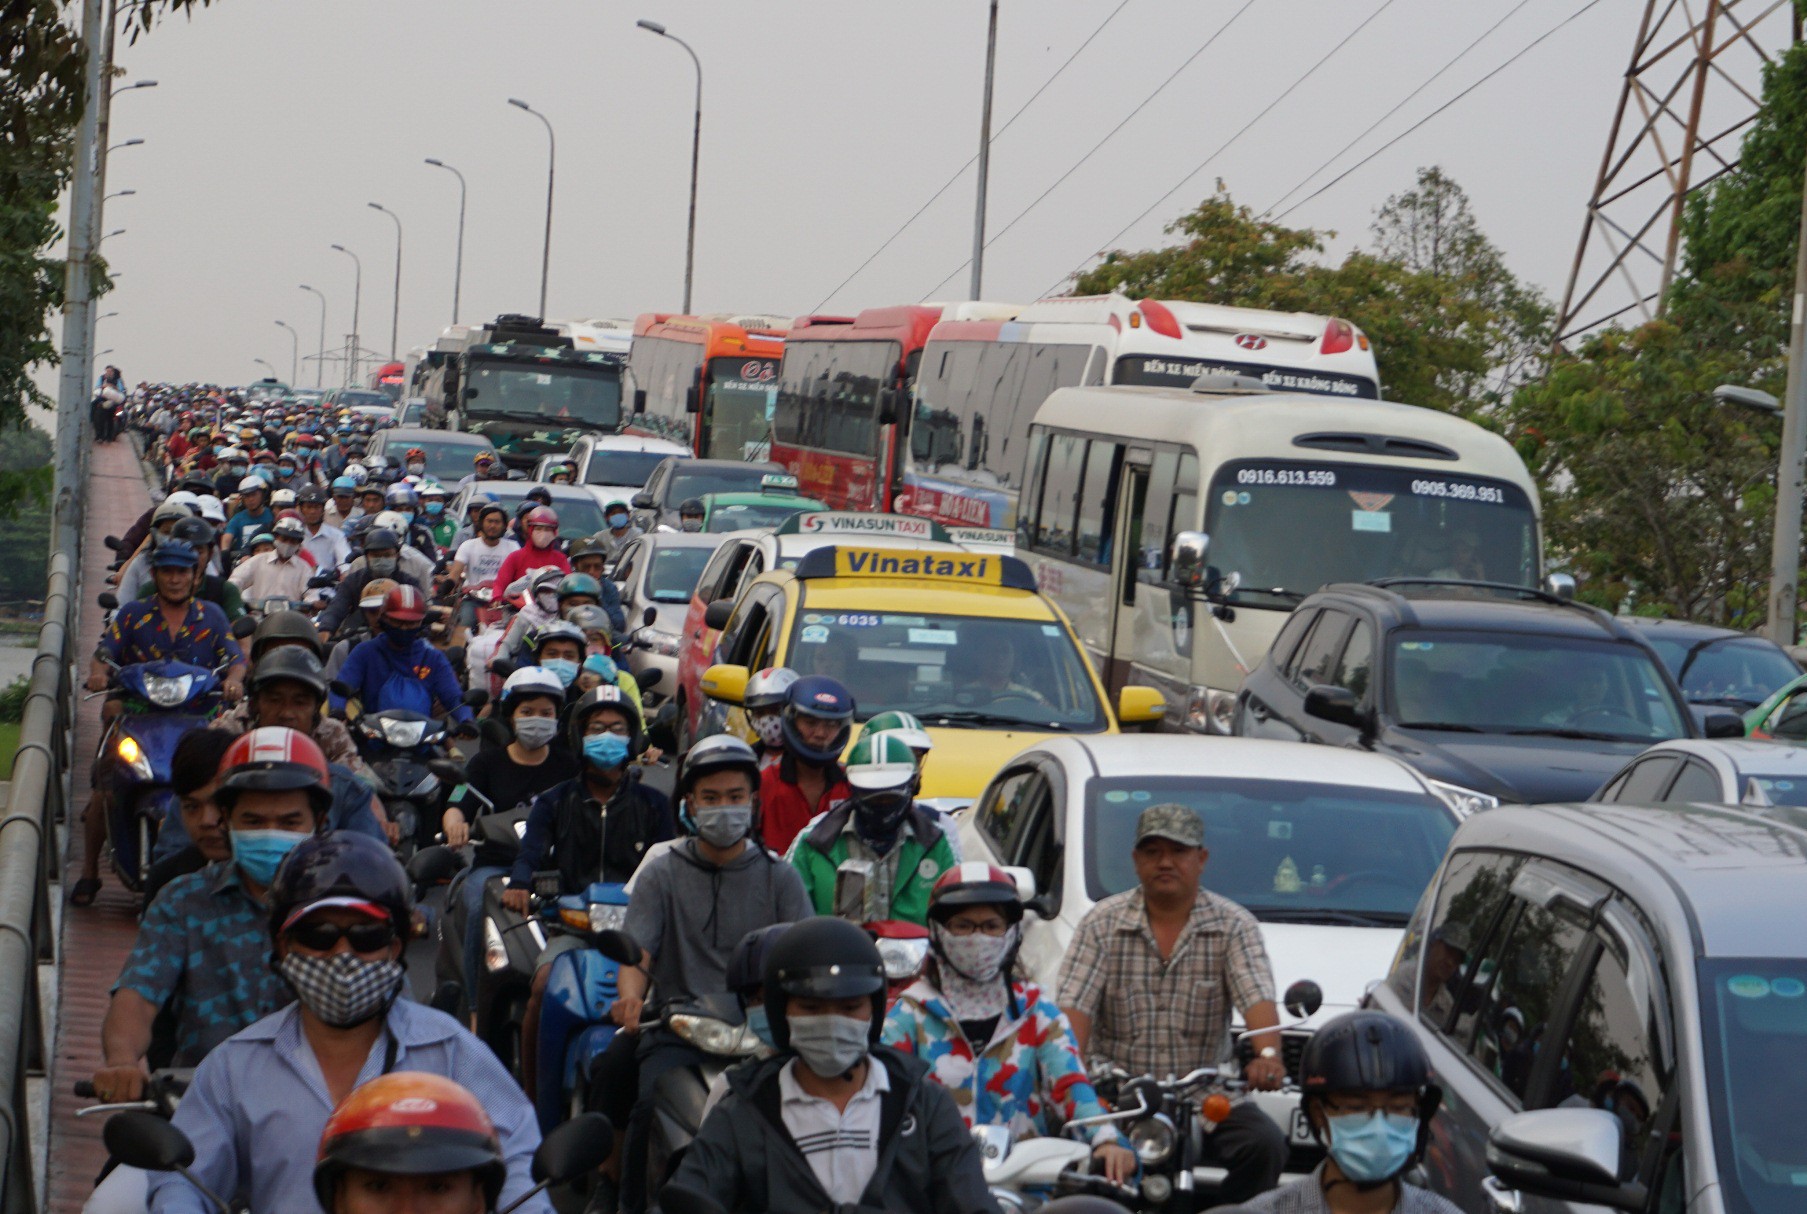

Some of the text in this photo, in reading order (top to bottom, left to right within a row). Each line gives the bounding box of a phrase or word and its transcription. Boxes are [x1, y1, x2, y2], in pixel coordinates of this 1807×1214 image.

[1237, 468, 1336, 486] 0916.613.559
[848, 552, 987, 578] Vinataxi
[838, 614, 879, 626] 6035
